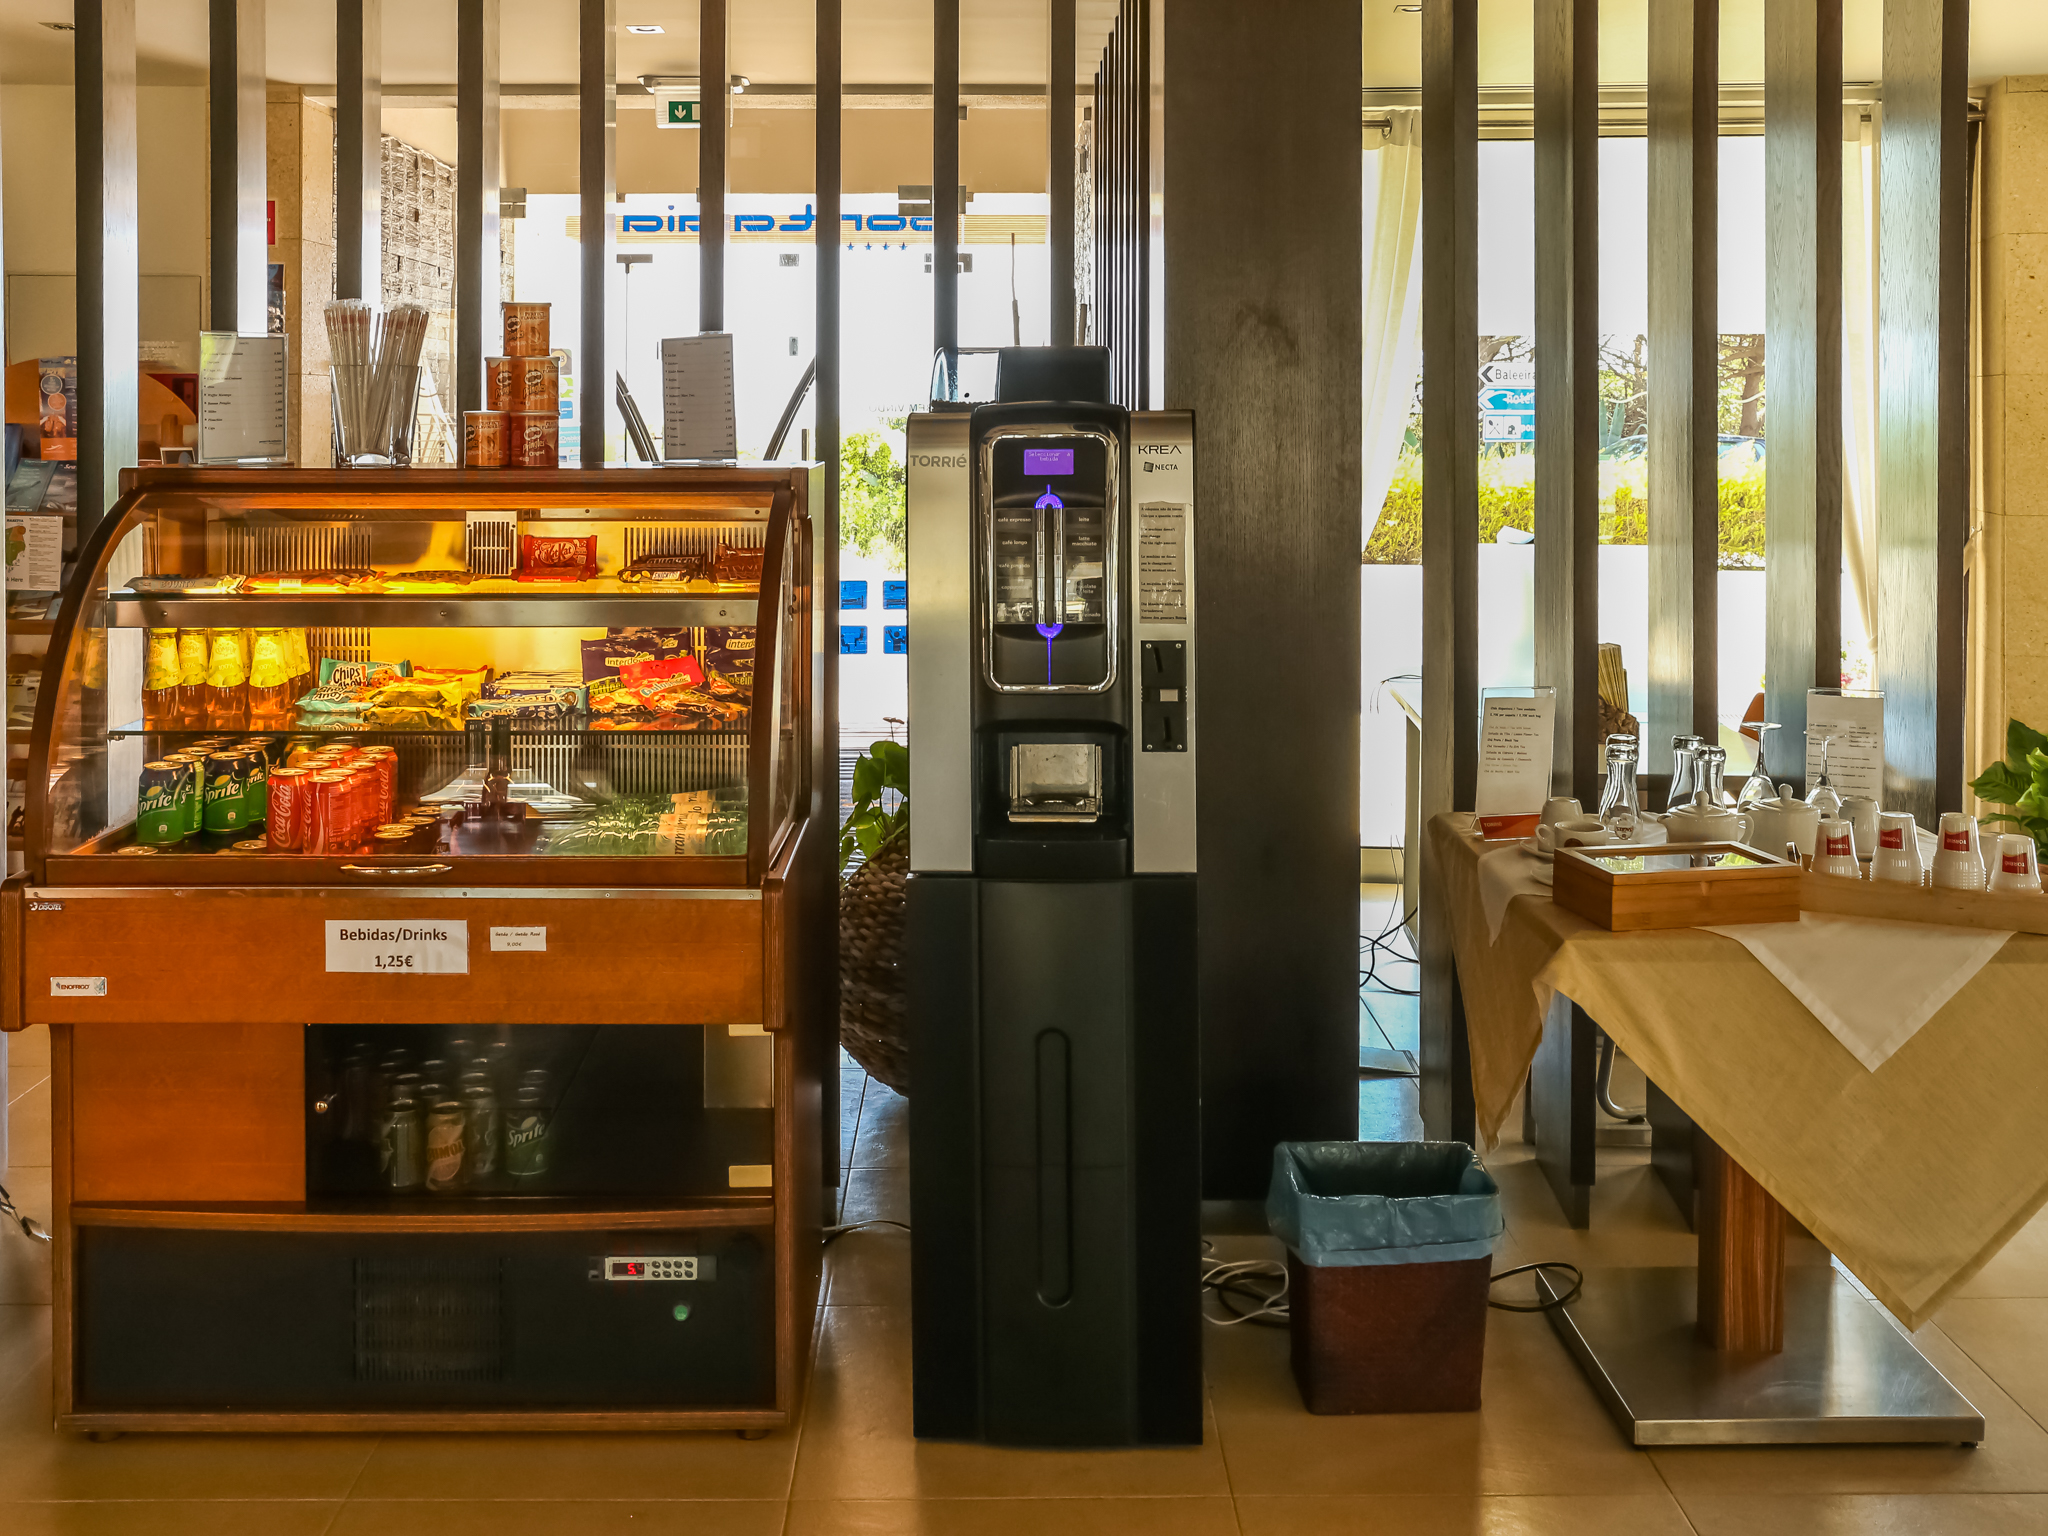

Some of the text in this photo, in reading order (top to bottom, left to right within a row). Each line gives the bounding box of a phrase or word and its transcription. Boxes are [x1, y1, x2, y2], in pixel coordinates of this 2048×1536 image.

[523, 383, 546, 397] Pringles
[522, 440, 545, 453] Pringles
[1138, 445, 1182, 454] KREA
[544, 543, 573, 563] KitKat
[160, 580, 196, 588] BOUNTY
[333, 667, 361, 684] Chips
[203, 781, 240, 803] Sprite
[340, 927, 448, 942] Bebidas/Drinks
[374, 955, 413, 970] 1,25€
[508, 1122, 545, 1148] Sprite
